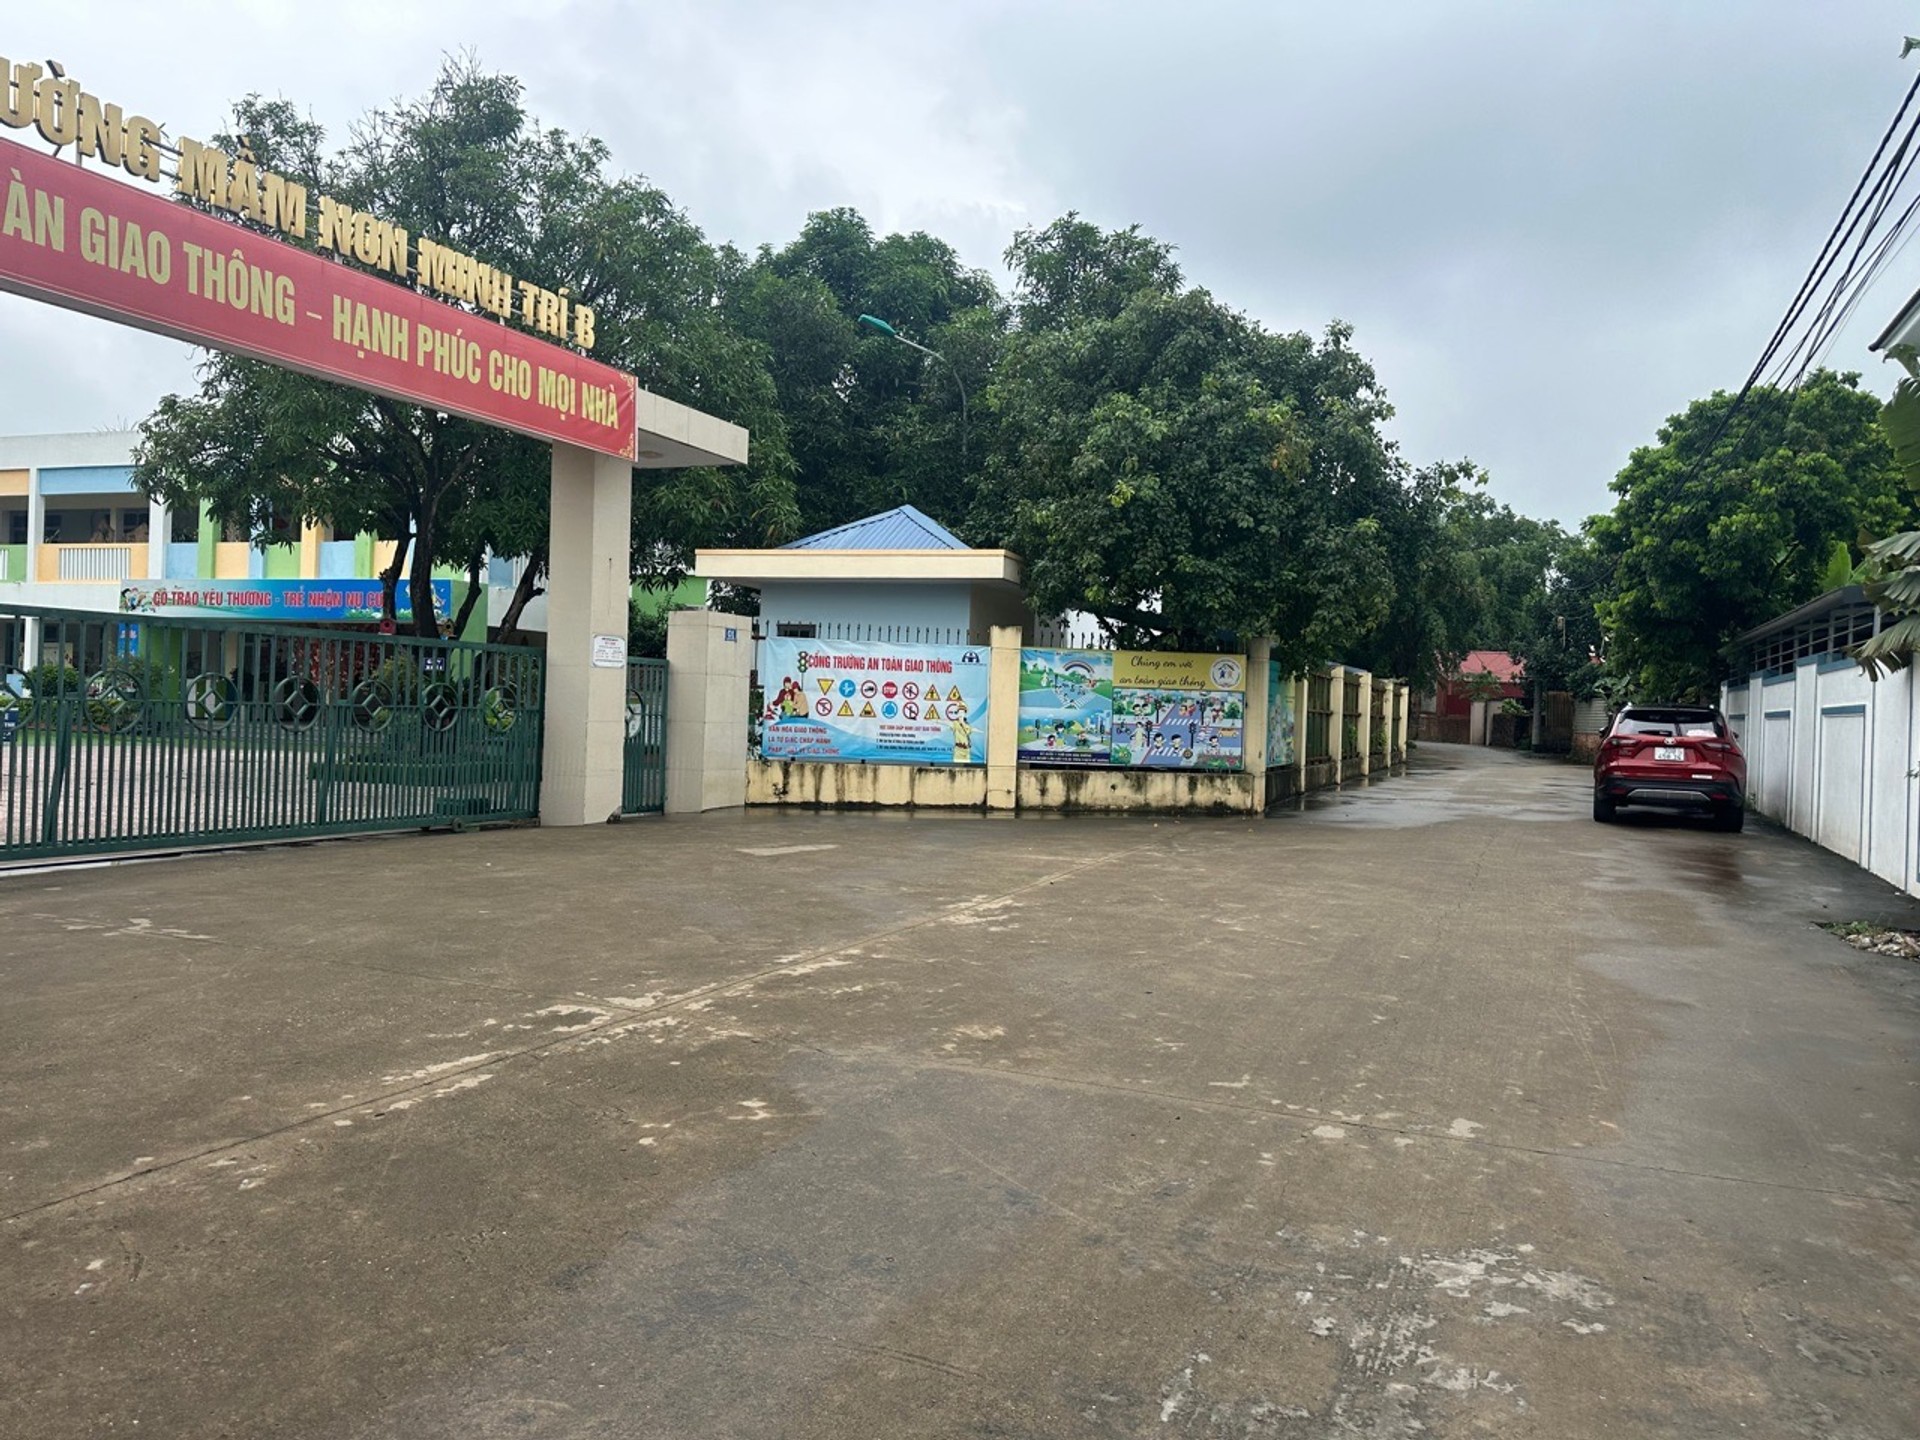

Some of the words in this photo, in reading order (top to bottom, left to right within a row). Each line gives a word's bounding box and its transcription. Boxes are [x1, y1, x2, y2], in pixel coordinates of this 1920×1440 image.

[178, 135, 307, 239] MẦM
[318, 195, 408, 278] NON
[417, 237, 512, 319] MINH
[519, 280, 569, 339] TRÍ
[575, 303, 596, 349] B
[2, 167, 64, 253] ÀN
[80, 207, 171, 285] GIAO
[183, 241, 295, 326] THÔNG
[333, 294, 409, 362] HẠNH
[417, 328, 481, 384] PHÚC
[489, 349, 532, 400] CHO
[538, 366, 576, 420] MỌI
[582, 382, 619, 430] NHÀ
[171, 591, 199, 607] TRAO
[202, 588, 223, 607] YÊU
[226, 590, 272, 607] THƯƠNG
[283, 586, 304, 608] TRẺ
[308, 588, 342, 611] NHẬN
[867, 657, 879, 670] AN
[881, 656, 902, 671] TOÀN
[904, 659, 923, 673] GIAO
[925, 657, 952, 673] THÔNG
[1130, 655, 1161, 669] Chúng
[1134, 675, 1155, 685] toàn
[1158, 677, 1177, 687] giao
[1179, 675, 1206, 688] thông
